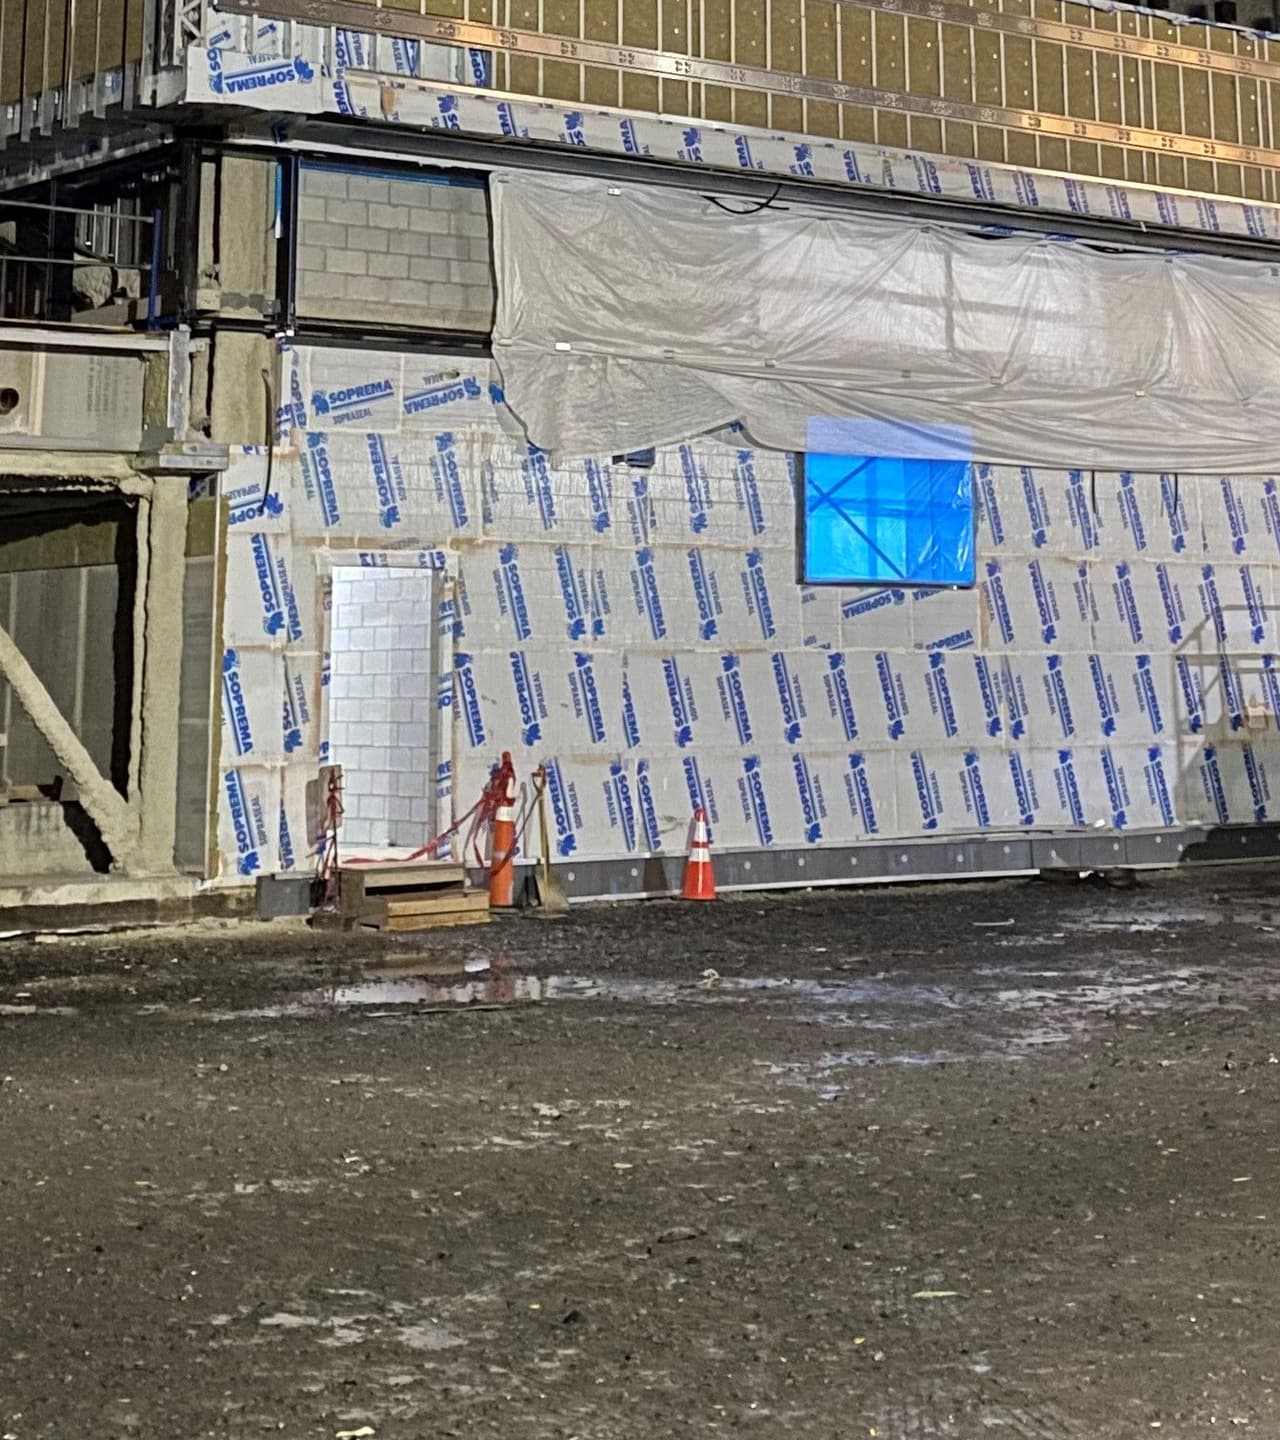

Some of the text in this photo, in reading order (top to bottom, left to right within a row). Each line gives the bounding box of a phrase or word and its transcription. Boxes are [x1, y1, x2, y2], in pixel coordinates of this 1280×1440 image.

[226, 69, 296, 93] SOPREMA
[330, 380, 393, 404] SOPREMA
[403, 387, 465, 414] SOPREMA
[316, 448, 340, 525] SOPREMA
[367, 433, 390, 506] SOPREMA
[445, 451, 468, 527] SOPREMA
[745, 464, 765, 534] SOPREMA
[228, 504, 264, 525] SOPR
[983, 479, 1004, 544] SOPREMA
[1128, 487, 1146, 550] SOPREMA
[1221, 478, 1238, 537] SOPREMA
[251, 533, 275, 613] SOPREMA
[509, 563, 532, 639] SOPREMA
[555, 548, 577, 619] SOPREMA
[644, 565, 667, 639] SOPREMA
[687, 549, 709, 620] SOPREMA
[755, 566, 776, 638] SOPREMA
[842, 594, 892, 619] SOPREMA
[1028, 561, 1049, 627] SOPREMA
[1156, 563, 1175, 627] SOPREMA
[1239, 566, 1258, 623] SOPREMA
[994, 577, 1015, 642] SOPREMA
[1123, 579, 1143, 642] SOPREMA
[1210, 580, 1227, 641] SOPREMA
[228, 671, 253, 753] SOPREMA
[462, 667, 486, 746] SOPREMA
[510, 652, 532, 725] SOPREMA
[583, 666, 605, 742] SOPREMA
[733, 670, 753, 744] SOPREMA
[771, 653, 792, 724] SOPREMA
[837, 669, 859, 739] SOPREMA
[875, 653, 895, 721] SOPREMA
[936, 667, 958, 736] SOPREMA
[1055, 670, 1076, 736] SOPREMA
[1088, 655, 1108, 718] SOPREMA
[1143, 668, 1164, 733] SOPREMA
[1176, 655, 1196, 716] SOPREMA
[1220, 655, 1237, 714] SOPREMA
[753, 771, 773, 846] SOPREMA
[792, 753, 813, 824] SOPREMA
[910, 751, 931, 819] SOPREMA
[1154, 761, 1174, 826] SOPREMA
[1210, 760, 1229, 822] SOPREMA
[1243, 746, 1261, 804] SOPREMA
[224, 770, 249, 854] SOPREMA
[639, 775, 662, 851] SOPREMA
